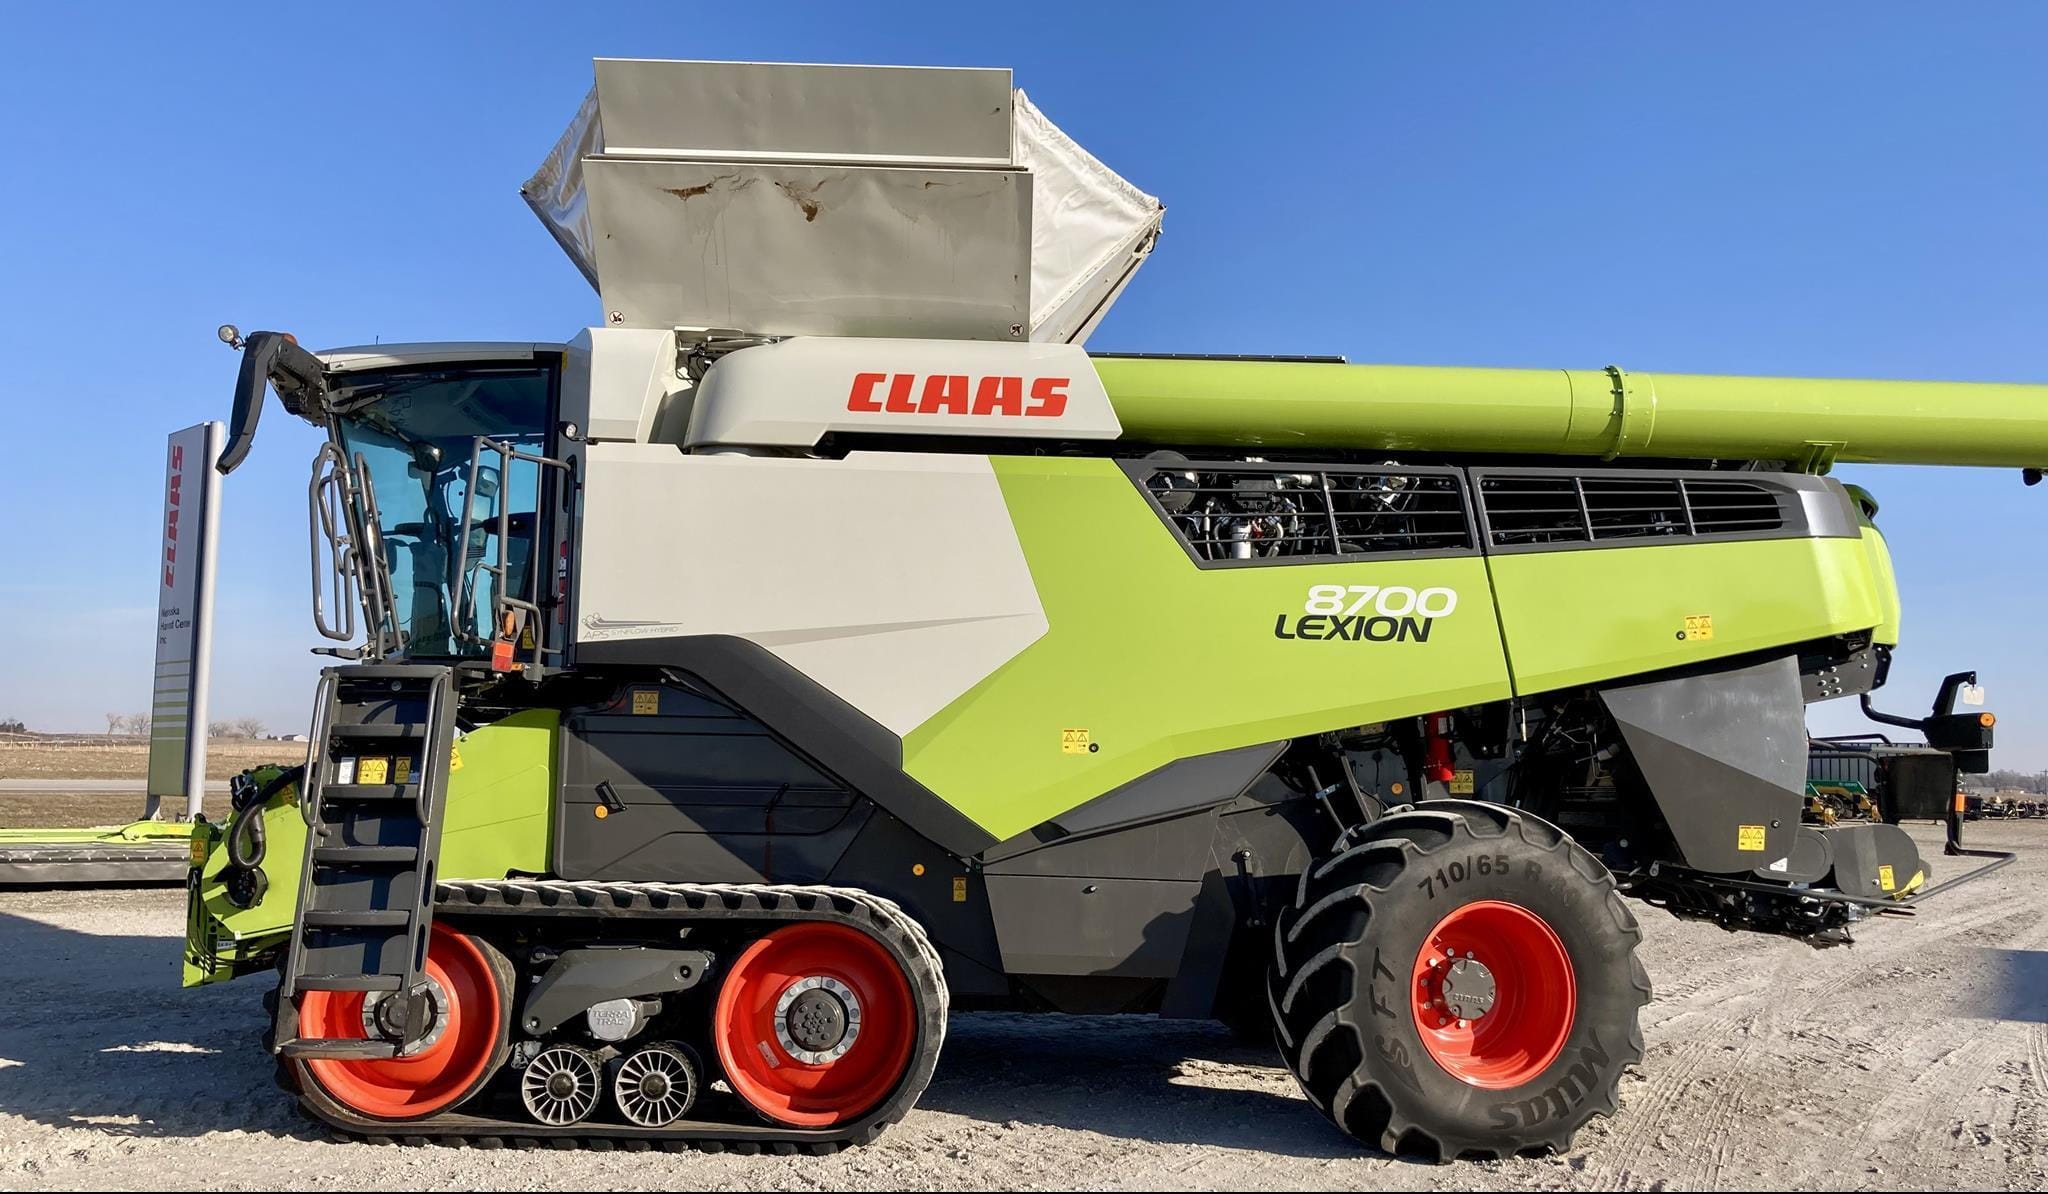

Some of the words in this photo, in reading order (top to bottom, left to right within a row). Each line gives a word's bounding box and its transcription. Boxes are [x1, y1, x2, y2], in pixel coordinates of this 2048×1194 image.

[846, 371, 1070, 417] CLAAS
[165, 444, 184, 589] CLAAS
[1304, 584, 1458, 618] 8700
[583, 631, 609, 640] APS
[1274, 614, 1433, 643] LEXION
[1417, 854, 1510, 901] 710/65
[1524, 859, 1543, 881] R
[592, 1010, 630, 1018] TERRA
[1489, 1029, 1612, 1130] Mitas
